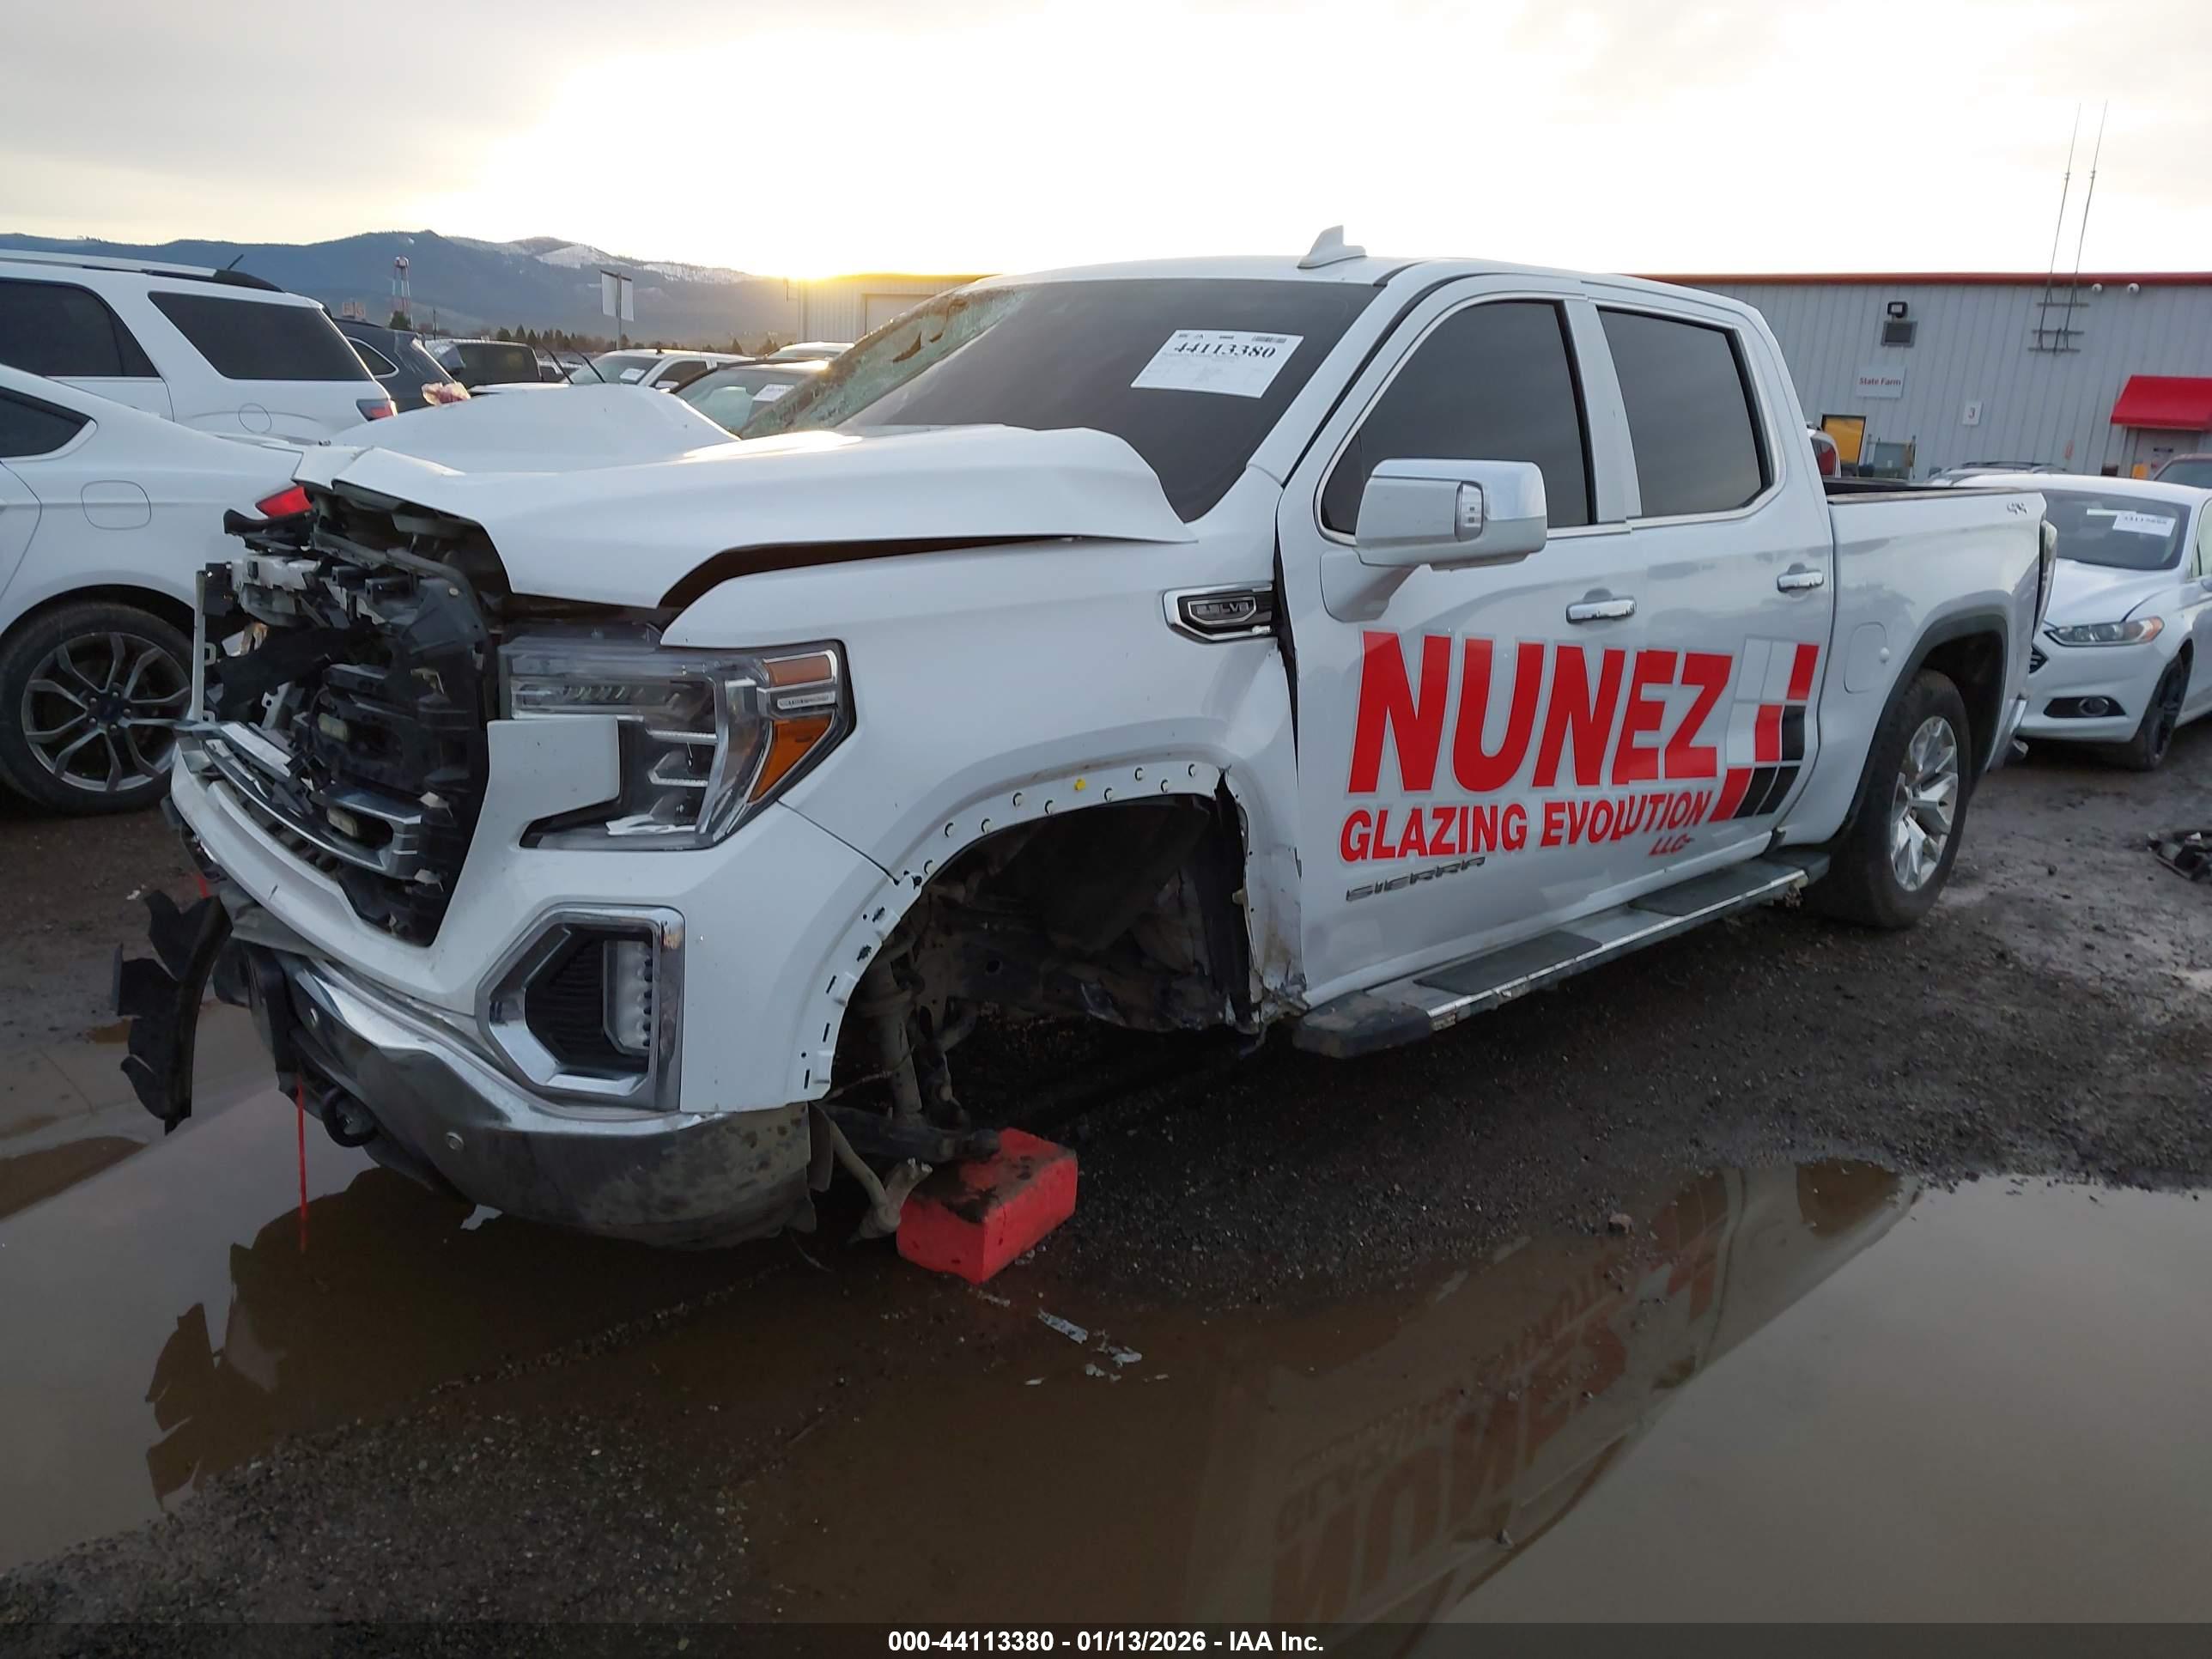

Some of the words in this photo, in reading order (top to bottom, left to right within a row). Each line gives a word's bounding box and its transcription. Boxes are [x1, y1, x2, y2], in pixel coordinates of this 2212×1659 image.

[1174, 342, 1277, 358] 44113380
[1859, 377, 1880, 386] State
[1881, 377, 1901, 386] Farm
[1348, 631, 1733, 792] NUNEZ
[1340, 803, 1527, 863] GLAZING
[1540, 790, 1714, 848] EVOLUTION
[1346, 856, 1486, 902] SIERRA
